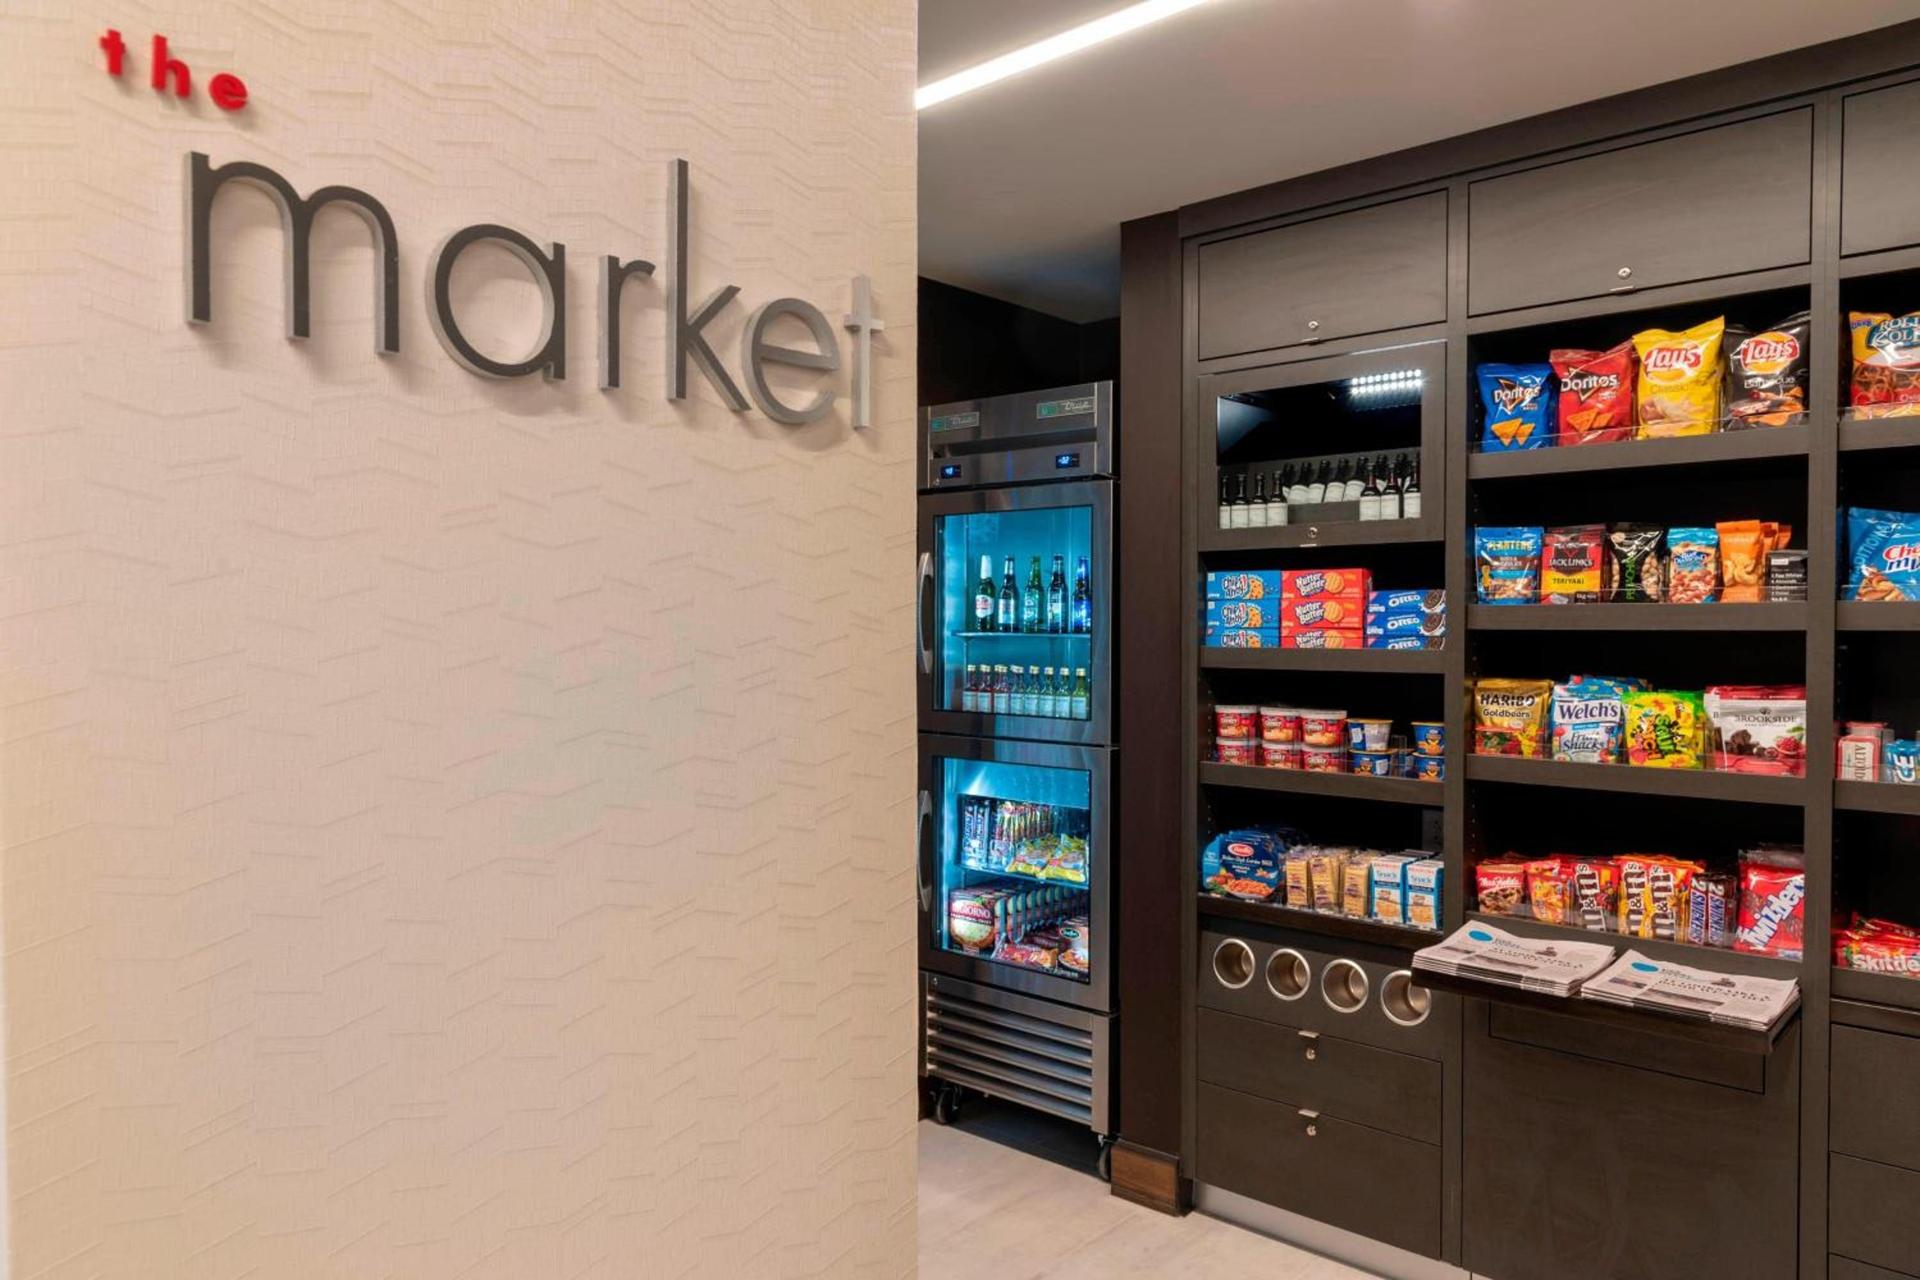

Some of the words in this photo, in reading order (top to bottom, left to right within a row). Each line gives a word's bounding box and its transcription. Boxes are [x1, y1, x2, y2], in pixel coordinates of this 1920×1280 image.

[100, 29, 248, 110] the
[183, 151, 885, 428] market
[1560, 374, 1619, 393] Doritos
[1493, 385, 1542, 404] Doritos
[1883, 542, 1920, 561] Che
[1885, 556, 1920, 573] mi
[1388, 594, 1421, 607] OREO
[1387, 617, 1420, 630] OREO
[1480, 694, 1535, 707] HARIBO
[1483, 708, 1530, 718] Goldbears
[1558, 702, 1619, 720] Welch's
[1855, 744, 1866, 780] ALTOID
[1690, 890, 1706, 943] SNICKERS
[1736, 876, 1805, 950] Twizzler
[1852, 953, 1920, 972] Skittle
